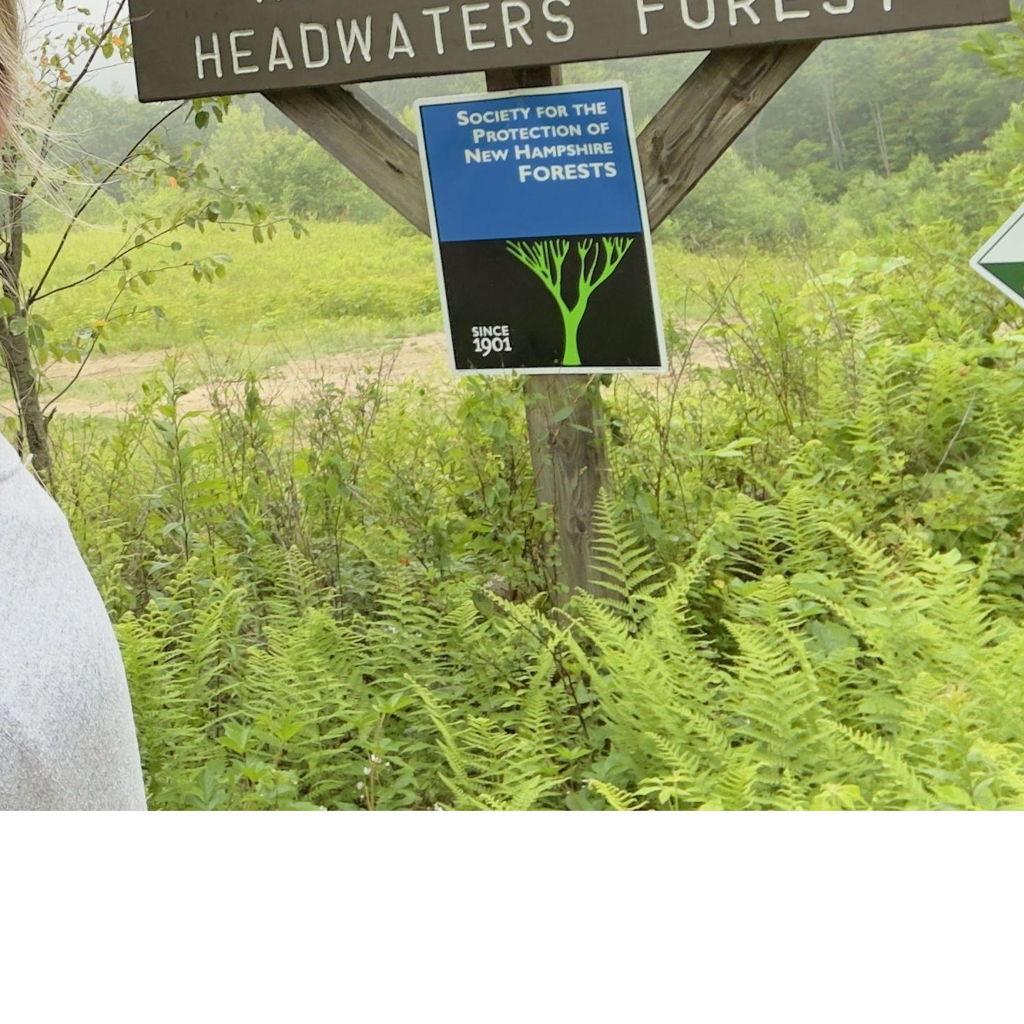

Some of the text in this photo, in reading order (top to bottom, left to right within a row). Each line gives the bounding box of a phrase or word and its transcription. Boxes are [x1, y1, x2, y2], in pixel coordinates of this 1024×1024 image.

[456, 102, 607, 126] SOCIETY FOR THE
[472, 122, 610, 144] PROTECTION OF
[464, 142, 614, 164] NEW HAMPSHIRE
[518, 162, 618, 183] FORESTS
[471, 325, 510, 337] SINCE
[473, 337, 513, 357] 1901
